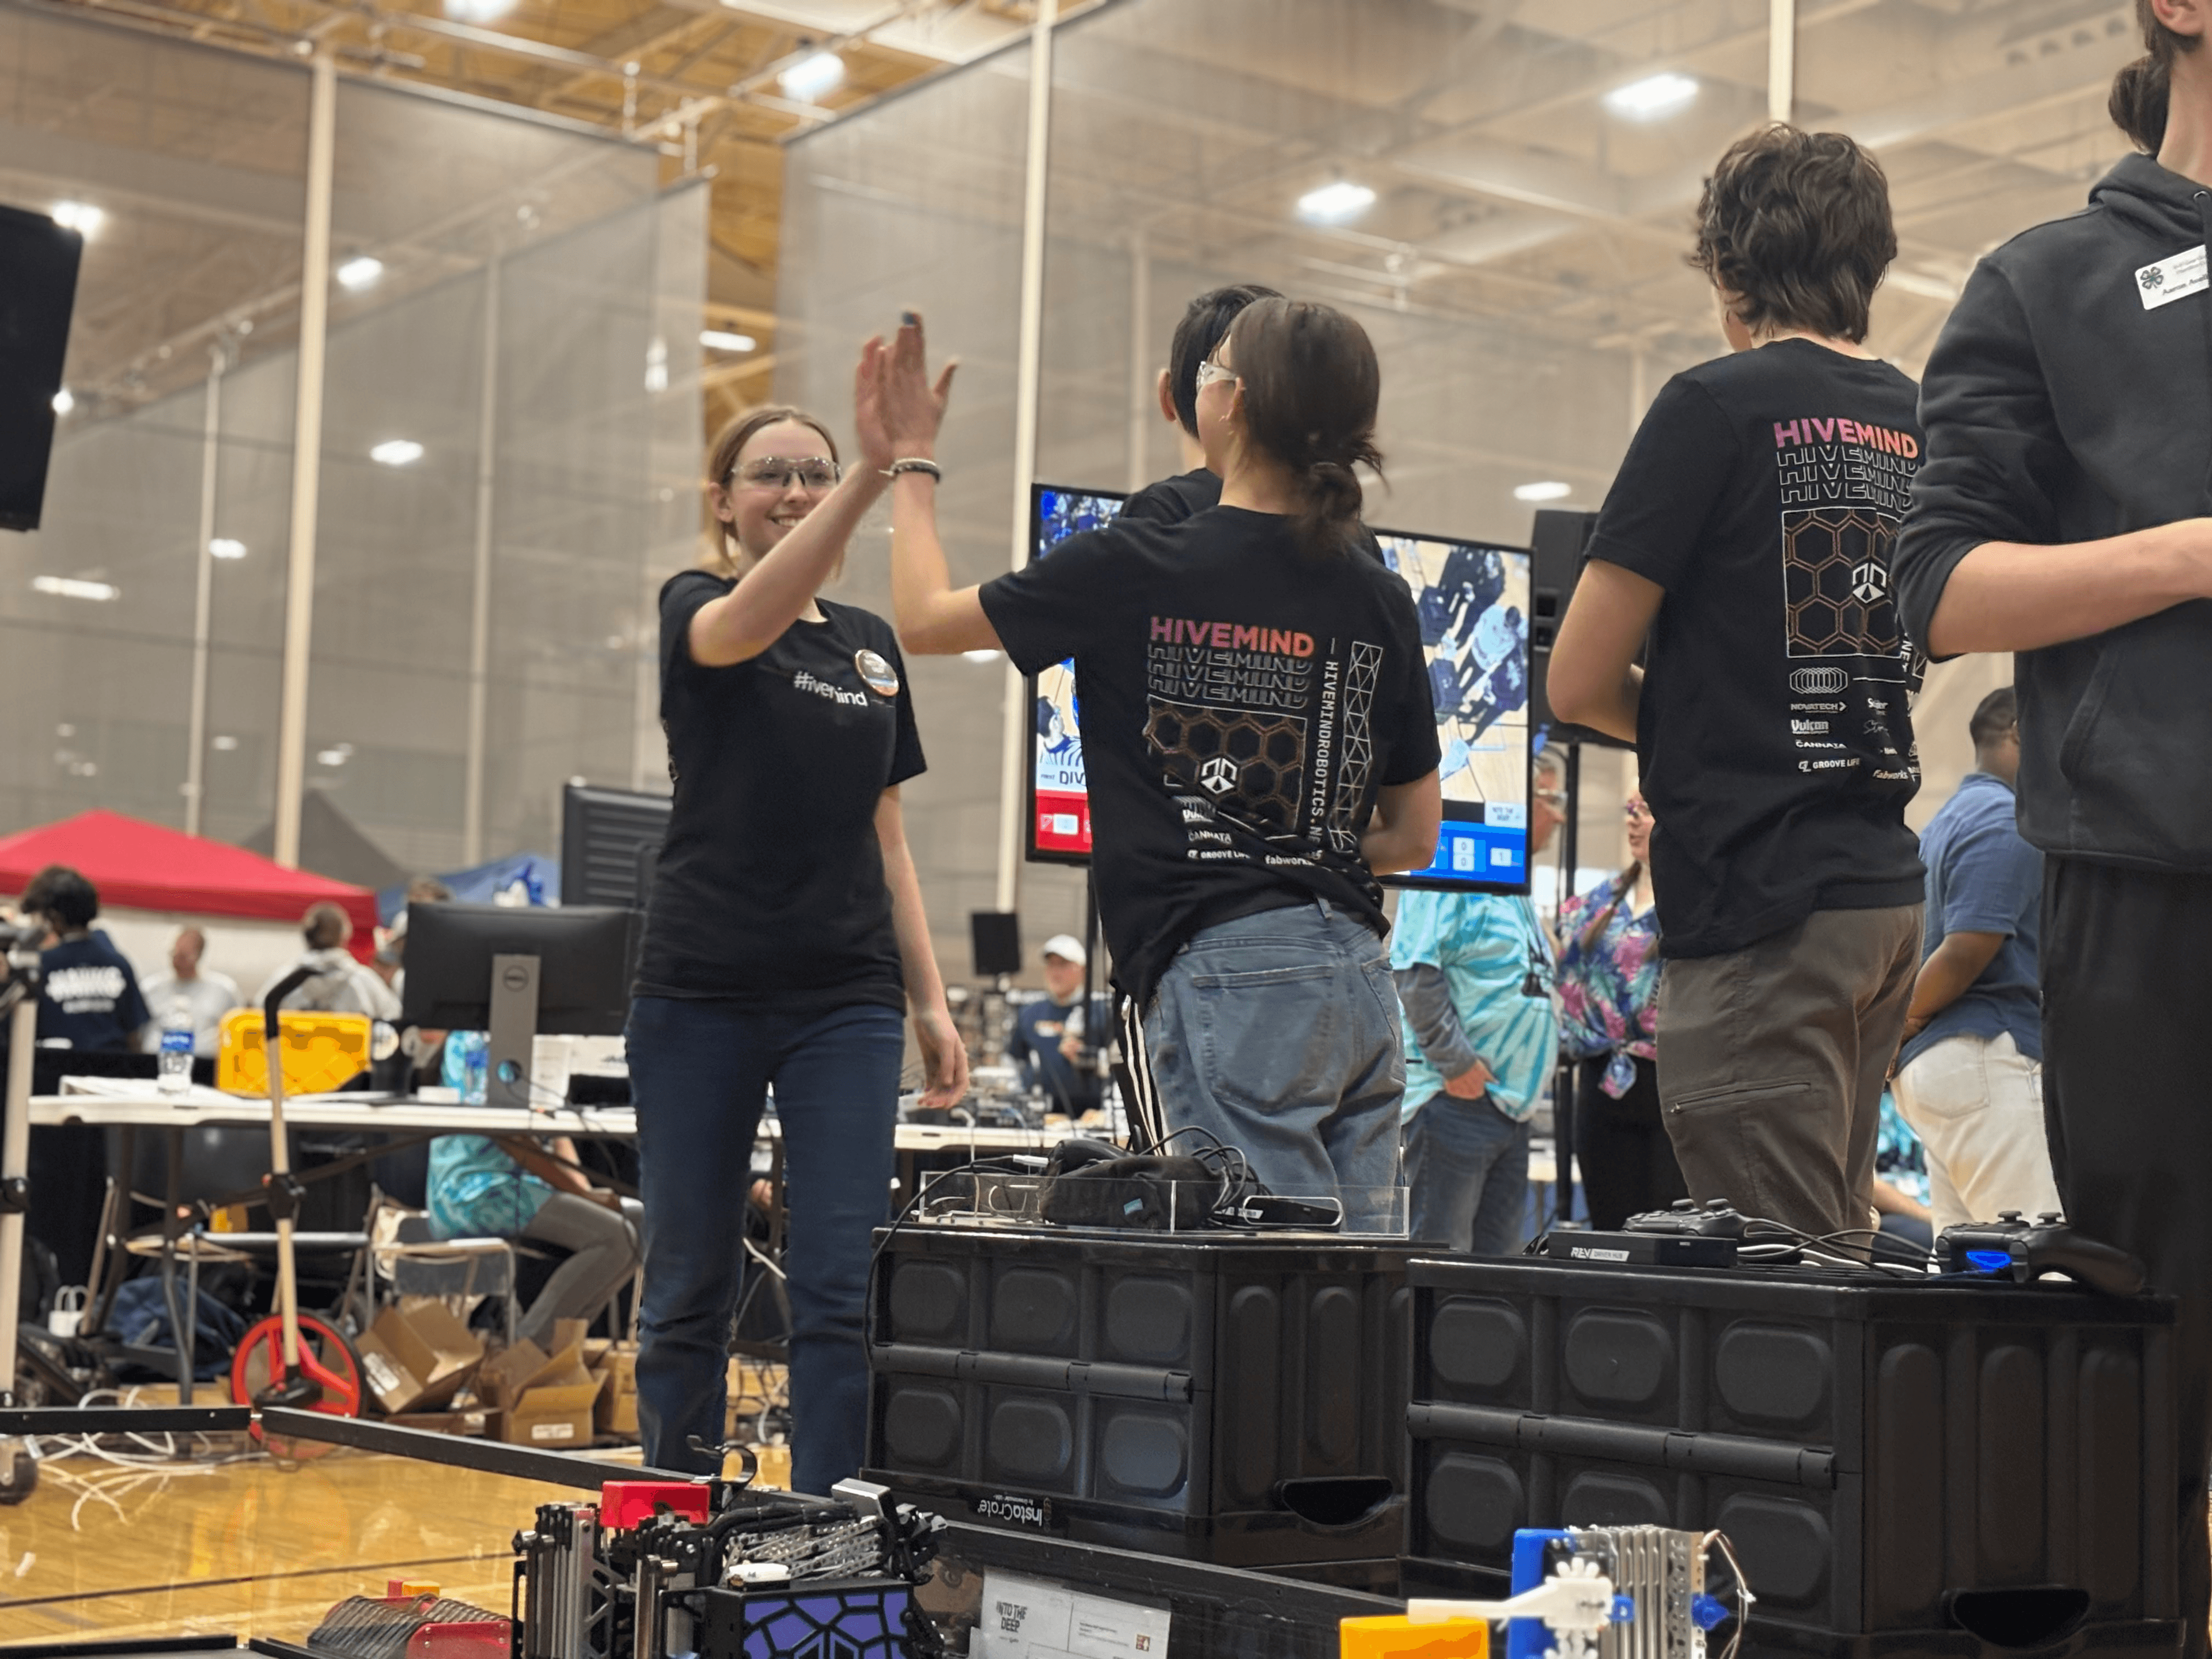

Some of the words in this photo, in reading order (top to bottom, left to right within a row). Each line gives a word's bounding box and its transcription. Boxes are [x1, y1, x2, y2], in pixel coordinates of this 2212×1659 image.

[1774, 418, 1919, 459] HIVEMIND
[1151, 616, 1315, 657] HIVEMIND
[1813, 759, 1846, 769] GROOVE
[1571, 1247, 1592, 1259] REV
[980, 1499, 1042, 1527] InstaCrate
